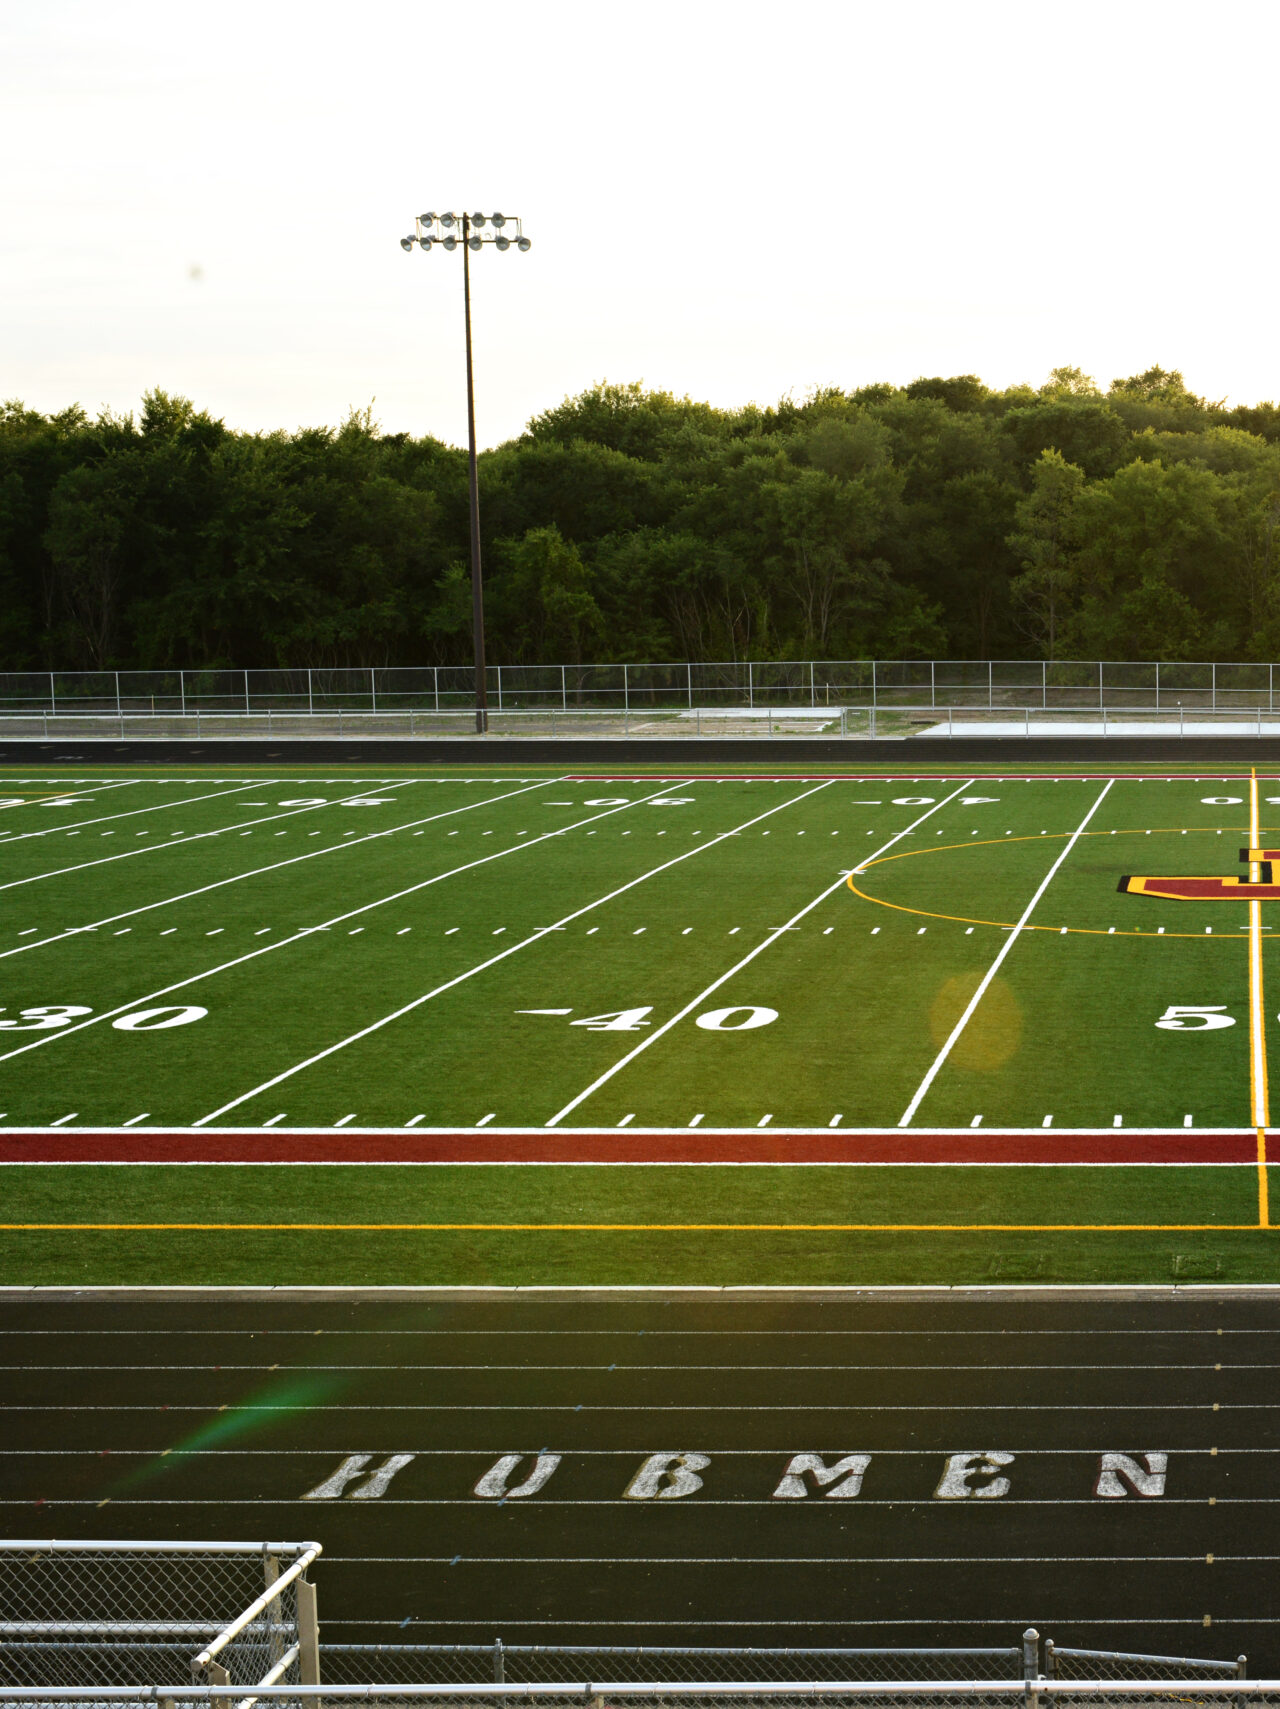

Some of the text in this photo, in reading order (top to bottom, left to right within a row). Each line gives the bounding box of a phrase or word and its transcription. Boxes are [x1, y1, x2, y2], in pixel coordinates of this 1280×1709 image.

[892, 796, 1000, 806] 40
[569, 1005, 779, 1031] 40
[302, 1451, 1169, 1501] HUBMEN
